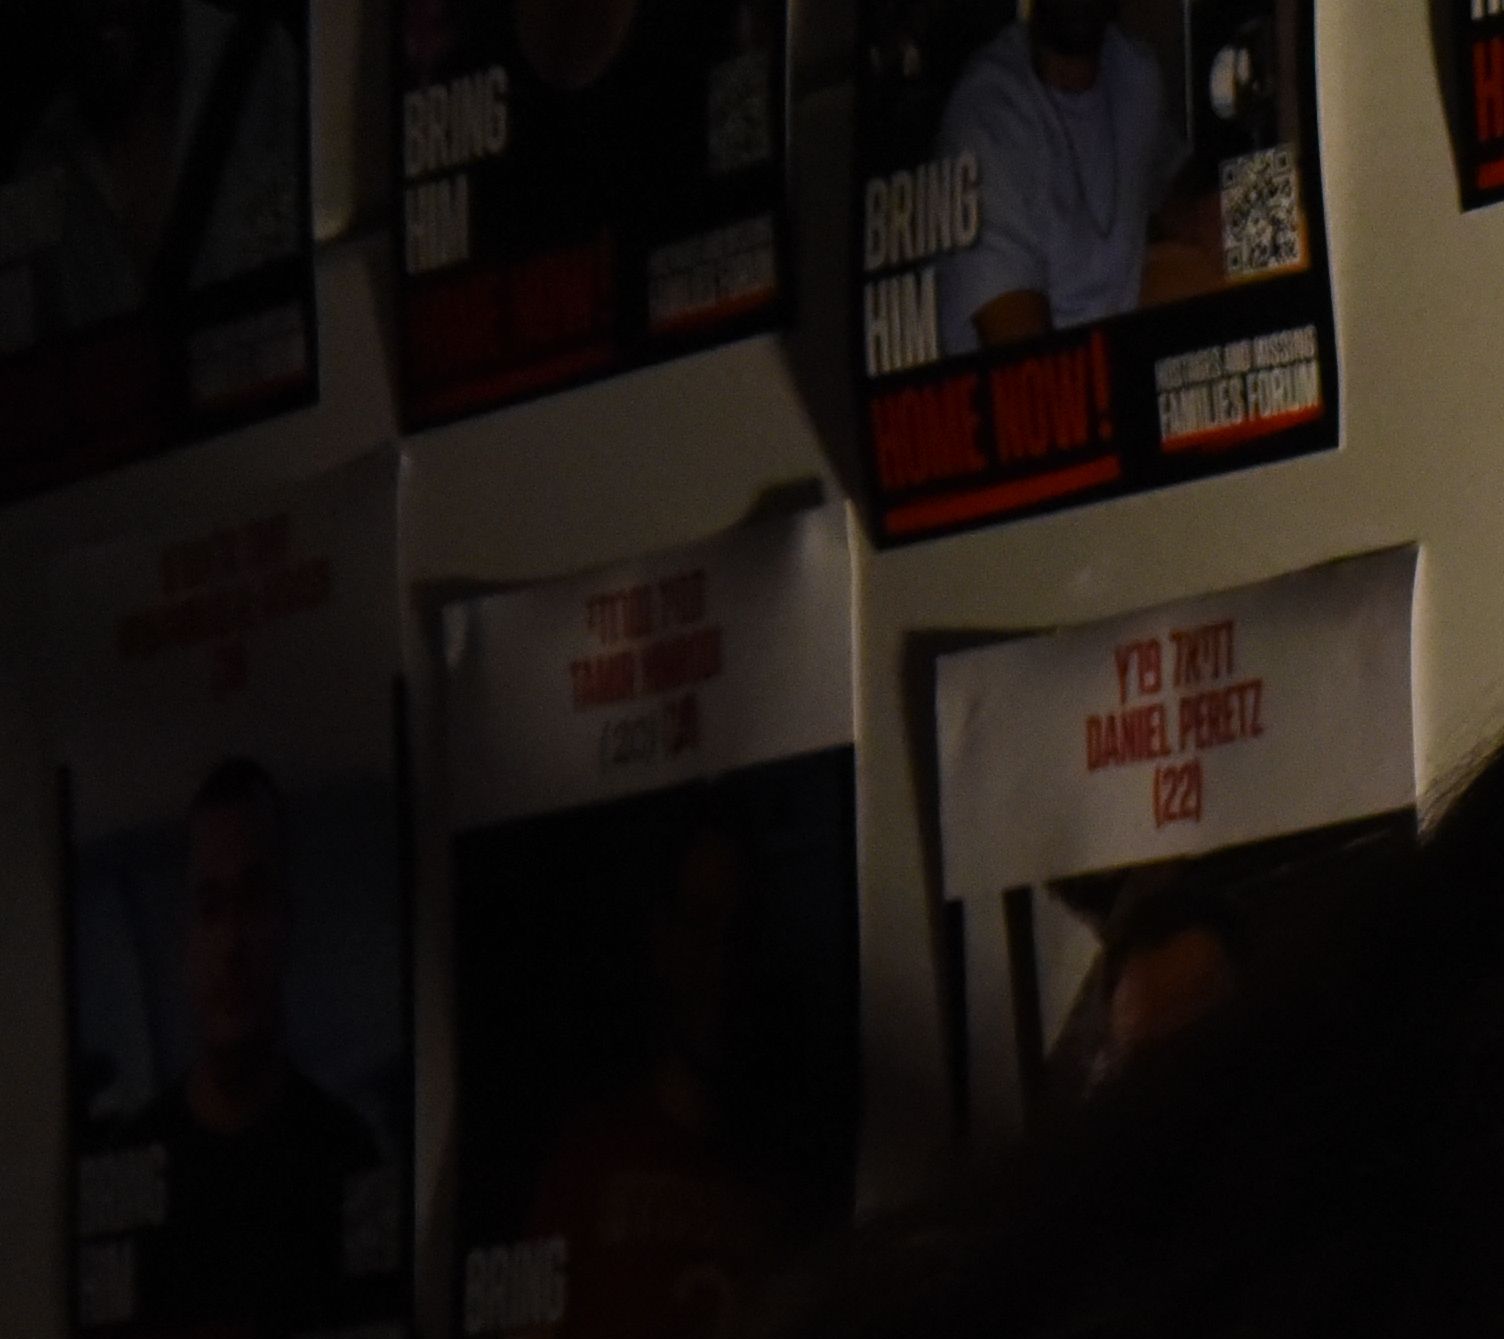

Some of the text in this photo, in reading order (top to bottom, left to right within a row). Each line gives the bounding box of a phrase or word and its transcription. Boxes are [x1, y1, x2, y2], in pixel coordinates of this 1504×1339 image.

[864, 148, 982, 274] BRING
[864, 262, 940, 380] HIM
[1086, 679, 1264, 772] DANIEL PERETZ
[1154, 757, 1203, 829] (22)
